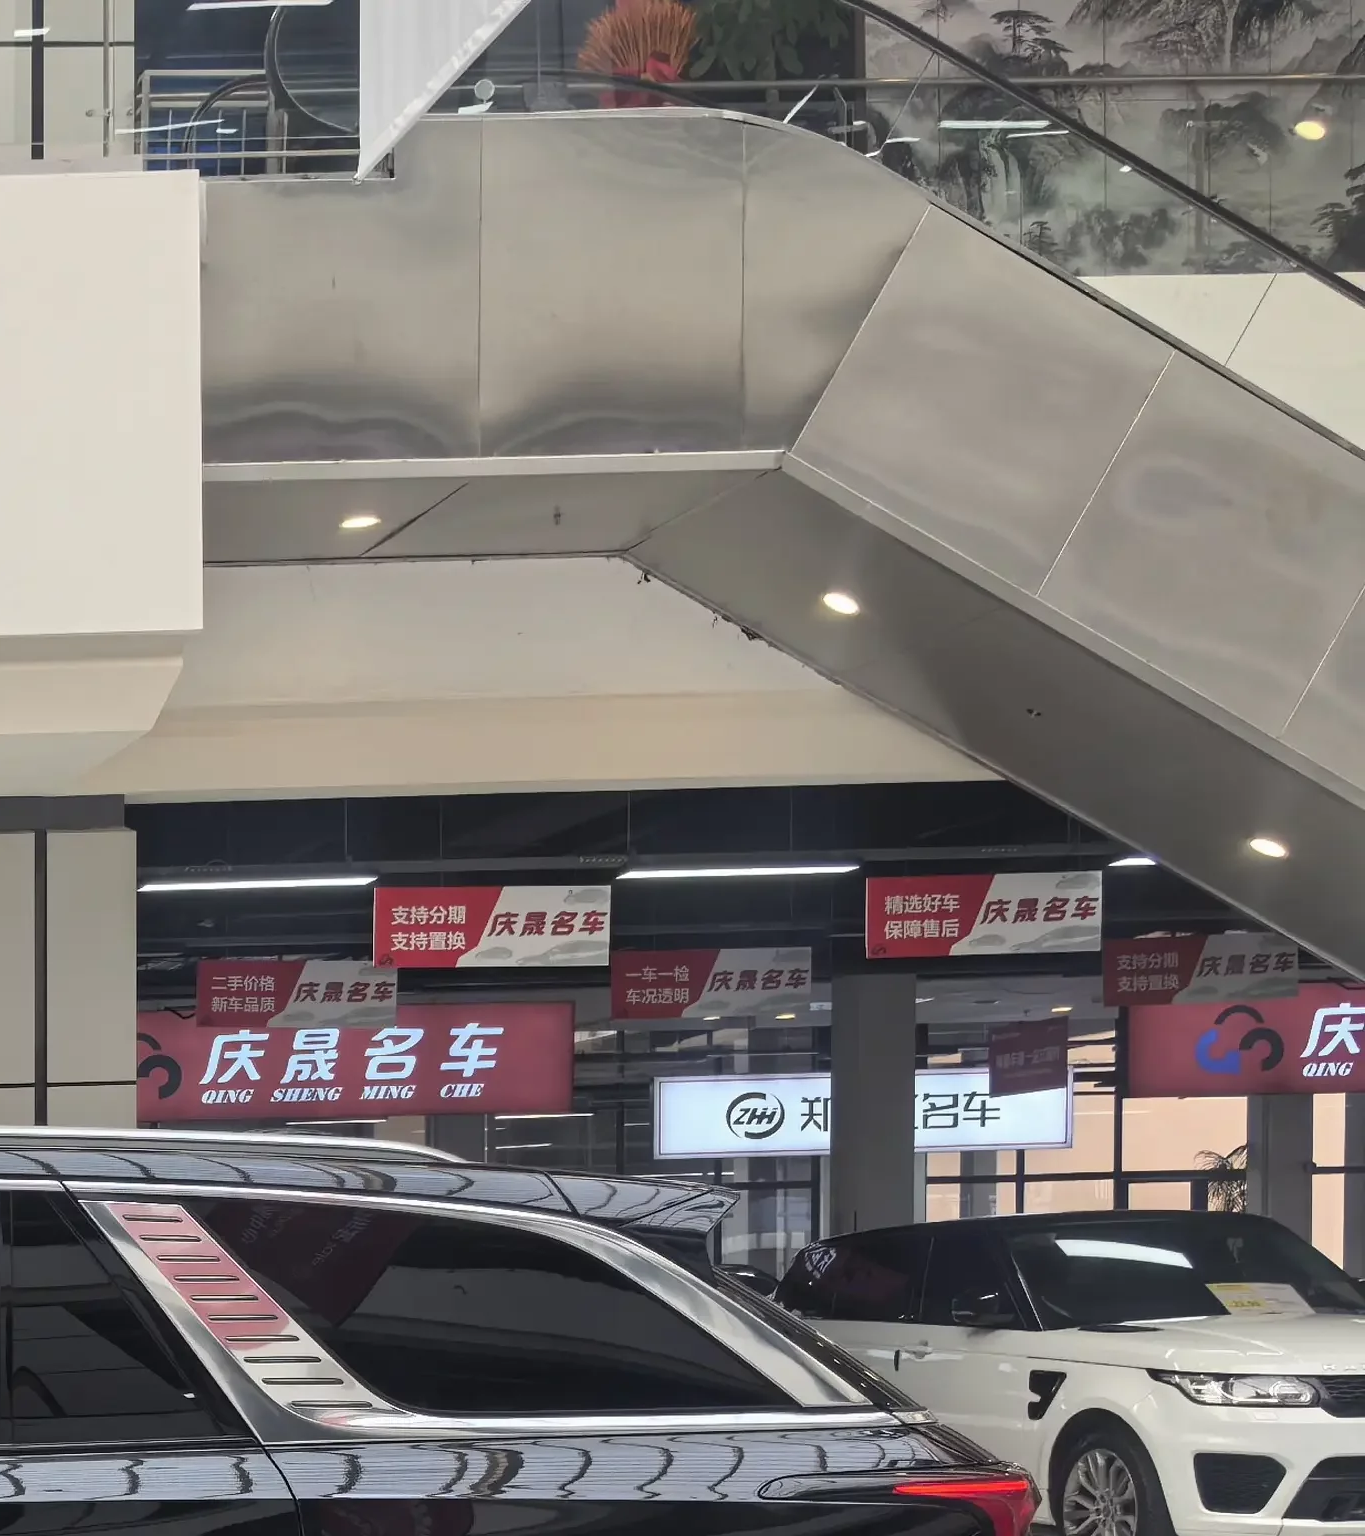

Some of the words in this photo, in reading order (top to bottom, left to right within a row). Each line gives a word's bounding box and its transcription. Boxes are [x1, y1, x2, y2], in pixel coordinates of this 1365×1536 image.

[884, 893, 960, 915] 精选好车
[980, 895, 1099, 925] 庆晟名车
[390, 905, 467, 926] 支持分期
[487, 910, 609, 937] 庆晟名车
[883, 918, 960, 940] 保障售后
[390, 931, 466, 951] 支持置换
[625, 965, 690, 983] 一车一检
[1196, 951, 1296, 978] 庆晟名车
[211, 975, 276, 993] 二手价格
[707, 968, 809, 993] 庆晟名车
[292, 981, 396, 1004] 庆晟名车
[625, 987, 690, 1005] 车况透明
[211, 995, 276, 1013] 新车品质
[199, 1022, 504, 1085] 庆晟名车
[1302, 1062, 1354, 1077] QING
[201, 1088, 255, 1104] QING
[270, 1086, 343, 1104] SHENG
[359, 1084, 416, 1101] MING
[439, 1083, 485, 1099] CHE
